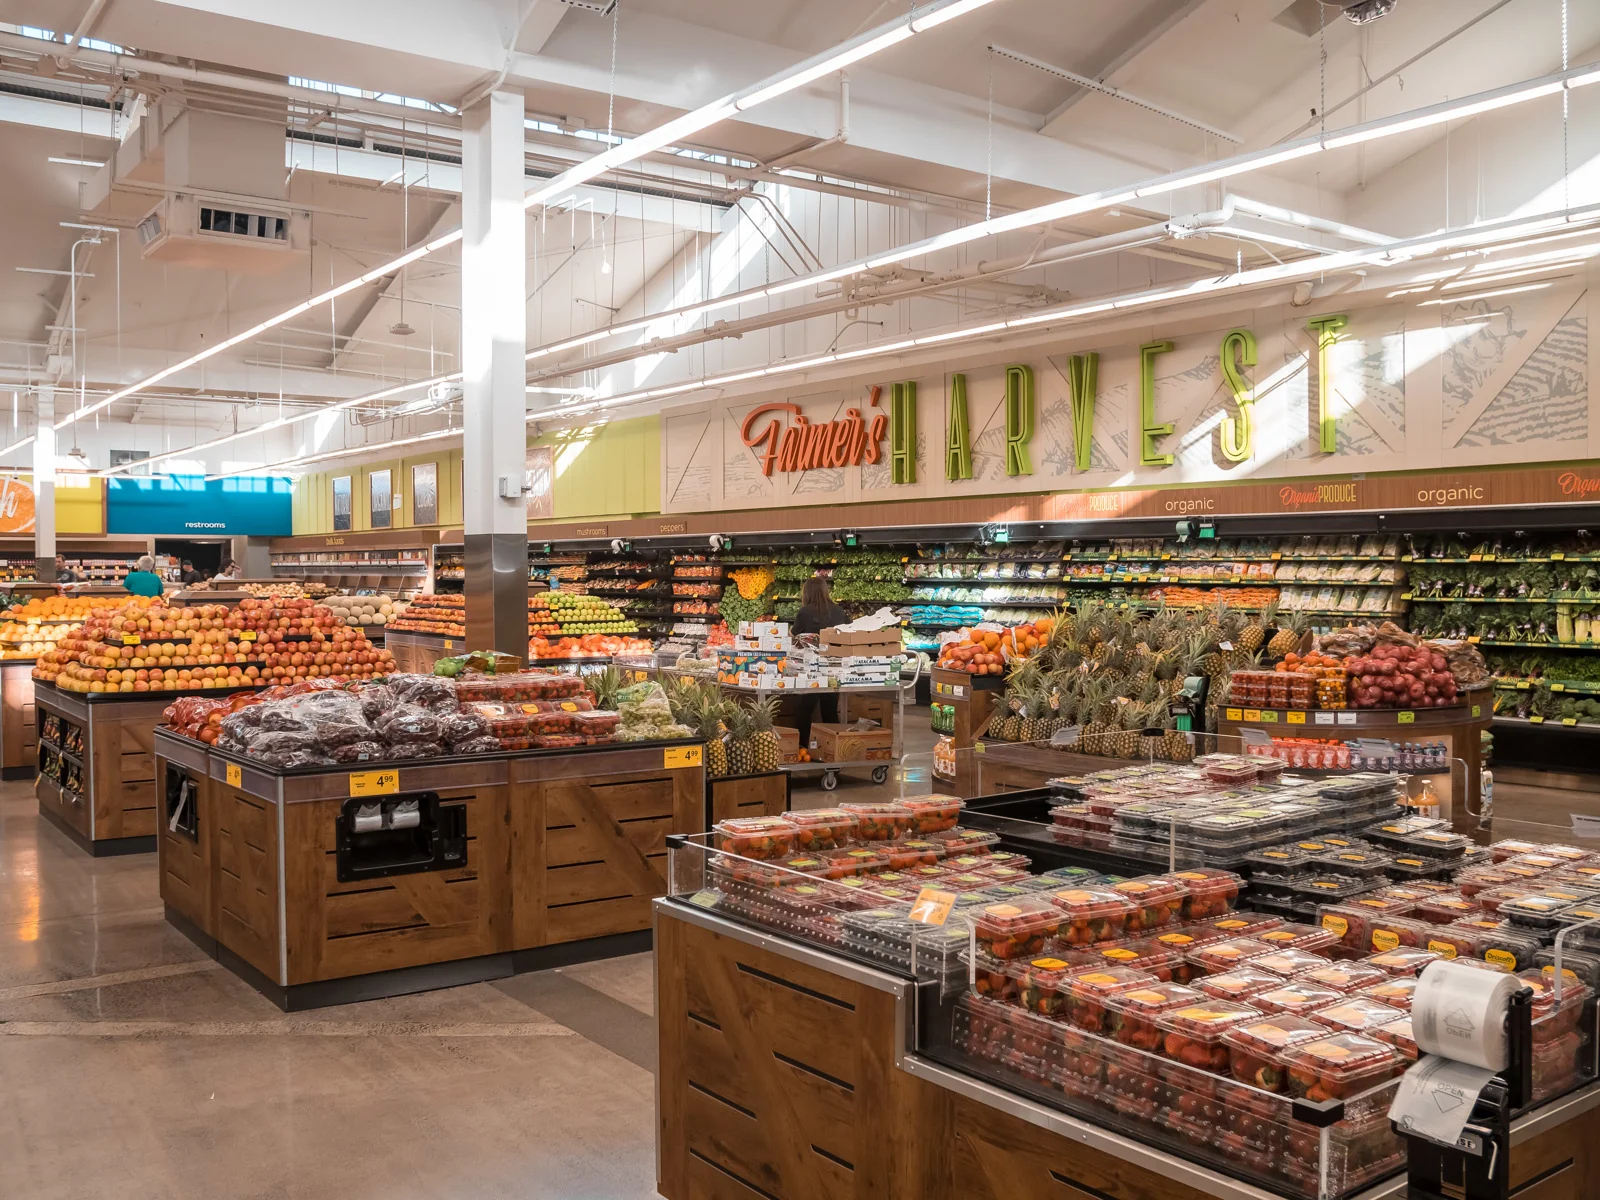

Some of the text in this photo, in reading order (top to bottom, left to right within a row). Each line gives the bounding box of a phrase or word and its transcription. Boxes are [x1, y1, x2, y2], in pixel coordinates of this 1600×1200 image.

[741, 315, 1348, 485] Farmer's HARVEST
[1319, 483, 1357, 503] PRODUCE
[1417, 485, 1484, 505] organic
[1165, 497, 1214, 514] organic
[185, 521, 226, 529] restrooms
[576, 527, 606, 536] mushrooms
[660, 523, 684, 534] peppers
[1437, 1082, 1465, 1097] OPEN
